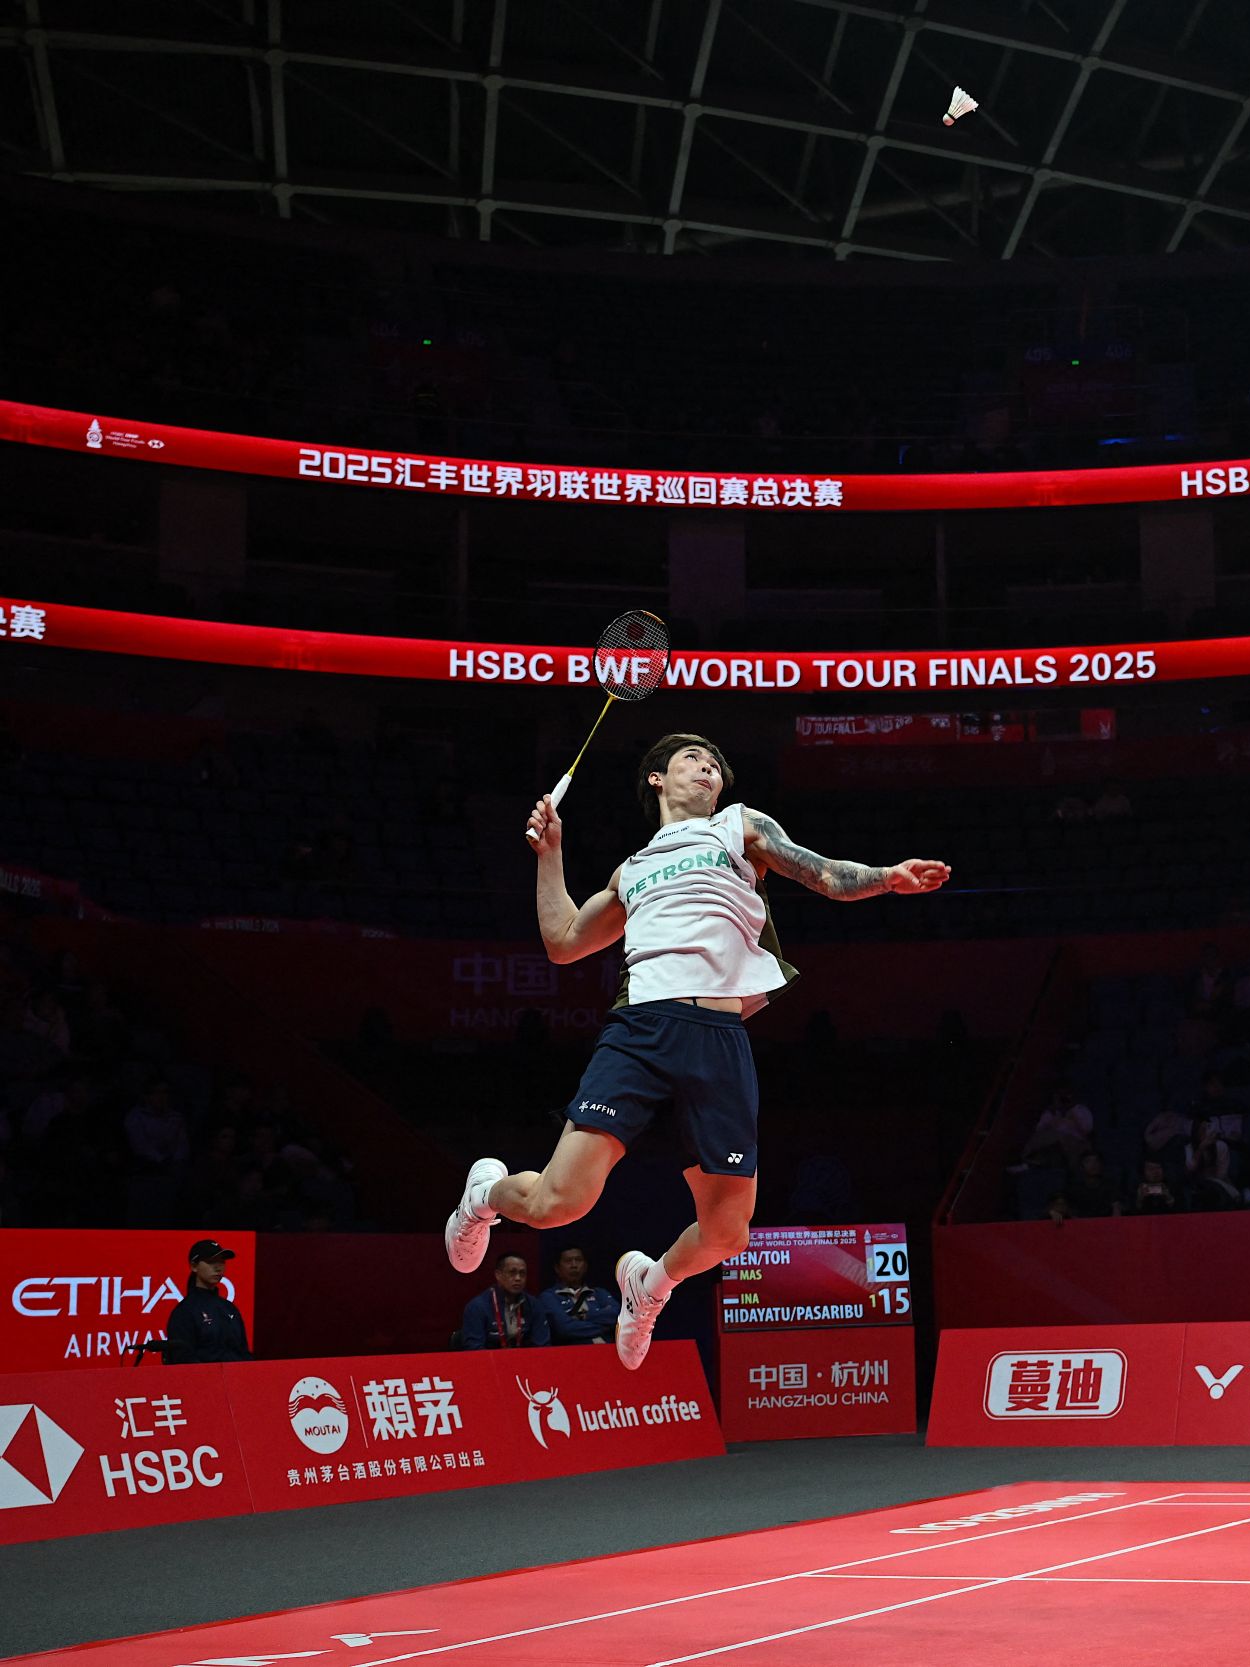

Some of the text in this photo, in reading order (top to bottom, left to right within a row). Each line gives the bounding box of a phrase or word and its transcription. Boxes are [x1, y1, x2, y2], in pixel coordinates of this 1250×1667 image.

[298, 448, 843, 507] 2025汇丰世界羽联世界巡回赛总决赛
[0, 604, 46, 640] 赛
[449, 649, 1156, 688] HSBC BWF WORLD TOUR FINALS 2025
[589, 1103, 617, 1117] AFFIN
[739, 1269, 762, 1281] MAS
[875, 1250, 907, 1277] 20
[12, 1277, 235, 1317] ETIHA
[724, 1304, 864, 1324] HIDAYATU/PASARIBU
[741, 1293, 760, 1305] INA
[869, 1287, 910, 1315] 1 15
[748, 1391, 889, 1409] HANGZHOU CHINA
[1005, 1359, 1103, 1412] 蔓迪
[114, 1394, 187, 1439] 汇丰
[304, 1424, 341, 1437] MOUTAI
[577, 1393, 701, 1432] luckin coffee
[99, 1445, 223, 1498] HSBC
[286, 1449, 486, 1487] 贵州茅台酒股份有限公司出品
